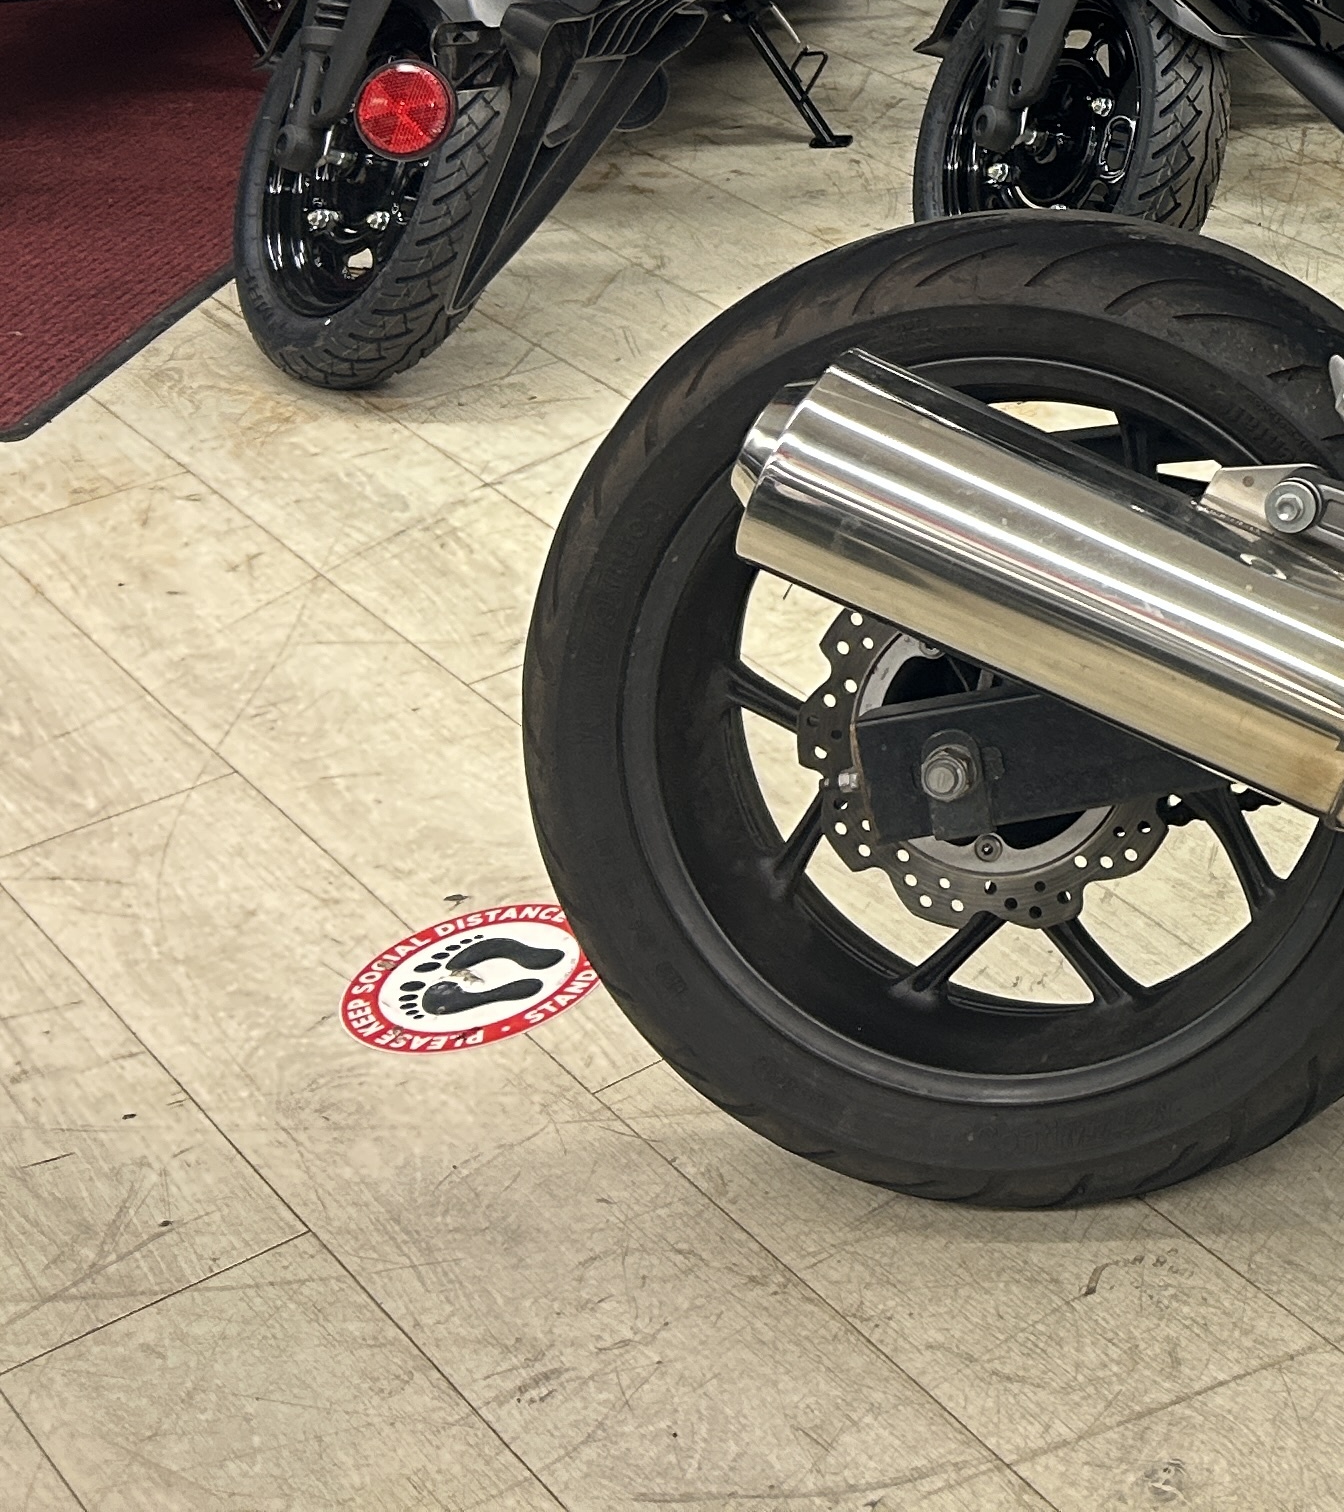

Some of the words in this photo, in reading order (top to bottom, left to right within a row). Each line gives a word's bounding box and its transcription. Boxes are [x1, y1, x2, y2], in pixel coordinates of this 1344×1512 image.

[433, 904, 567, 936] DISTANCE
[351, 936, 432, 995] SOCIAL
[524, 969, 598, 1024] STAND
[347, 999, 386, 1038] KEEP
[375, 1027, 485, 1051] PLEASE
